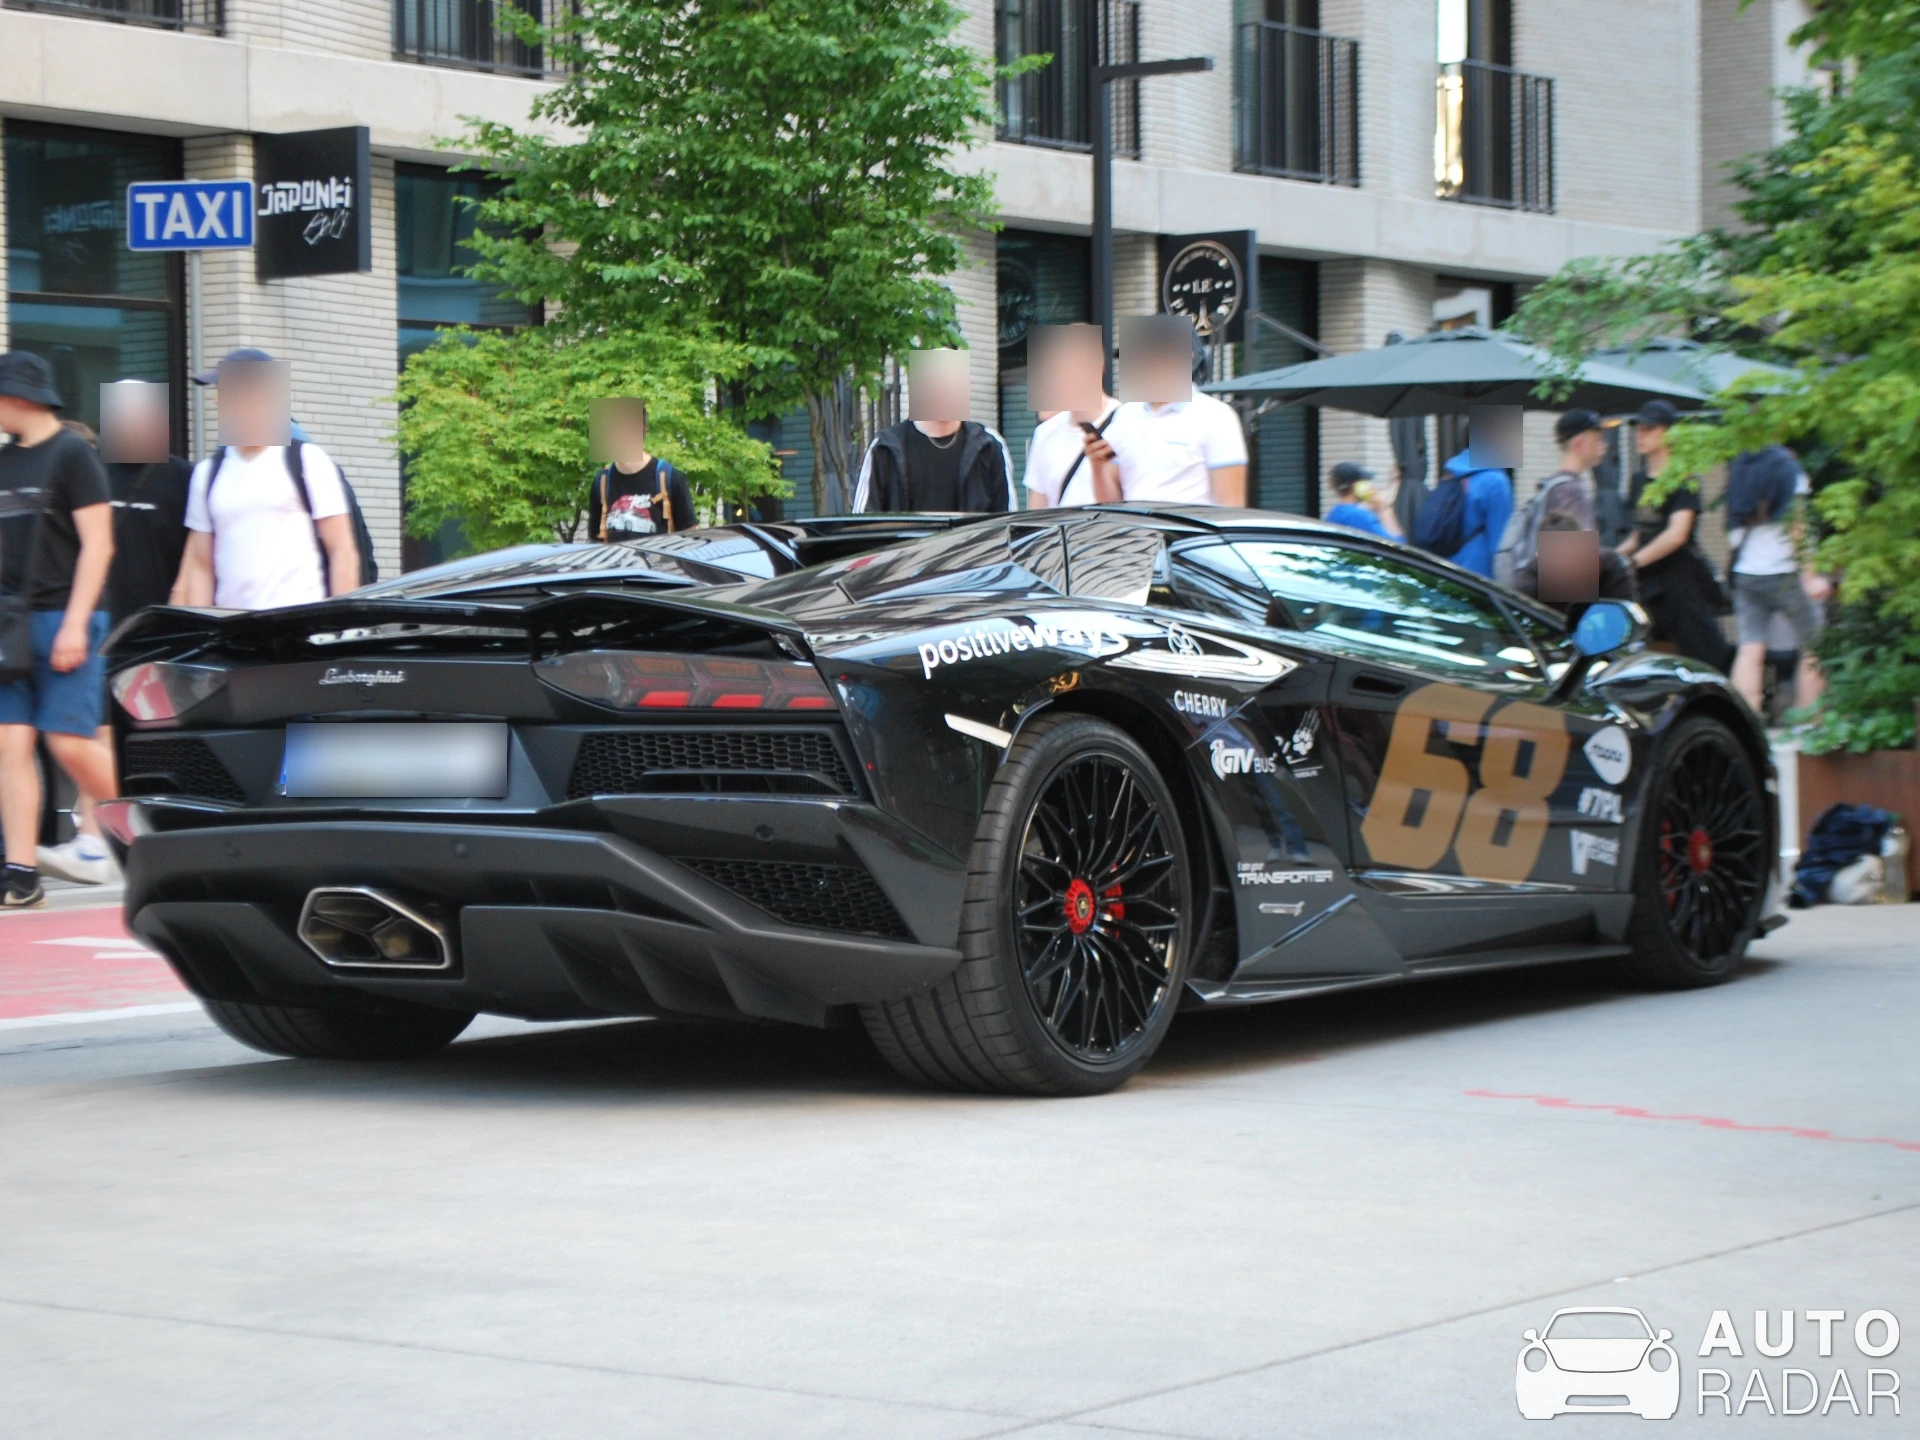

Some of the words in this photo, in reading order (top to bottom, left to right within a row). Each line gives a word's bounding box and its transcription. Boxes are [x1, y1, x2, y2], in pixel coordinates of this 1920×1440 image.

[135, 190, 244, 241] TAXI
[318, 667, 406, 686] Lamborghini
[1173, 689, 1228, 719] CHERRY
[1253, 756, 1277, 774] BUS
[1360, 681, 1571, 885] 68
[1237, 870, 1334, 886] TRANSPORTER
